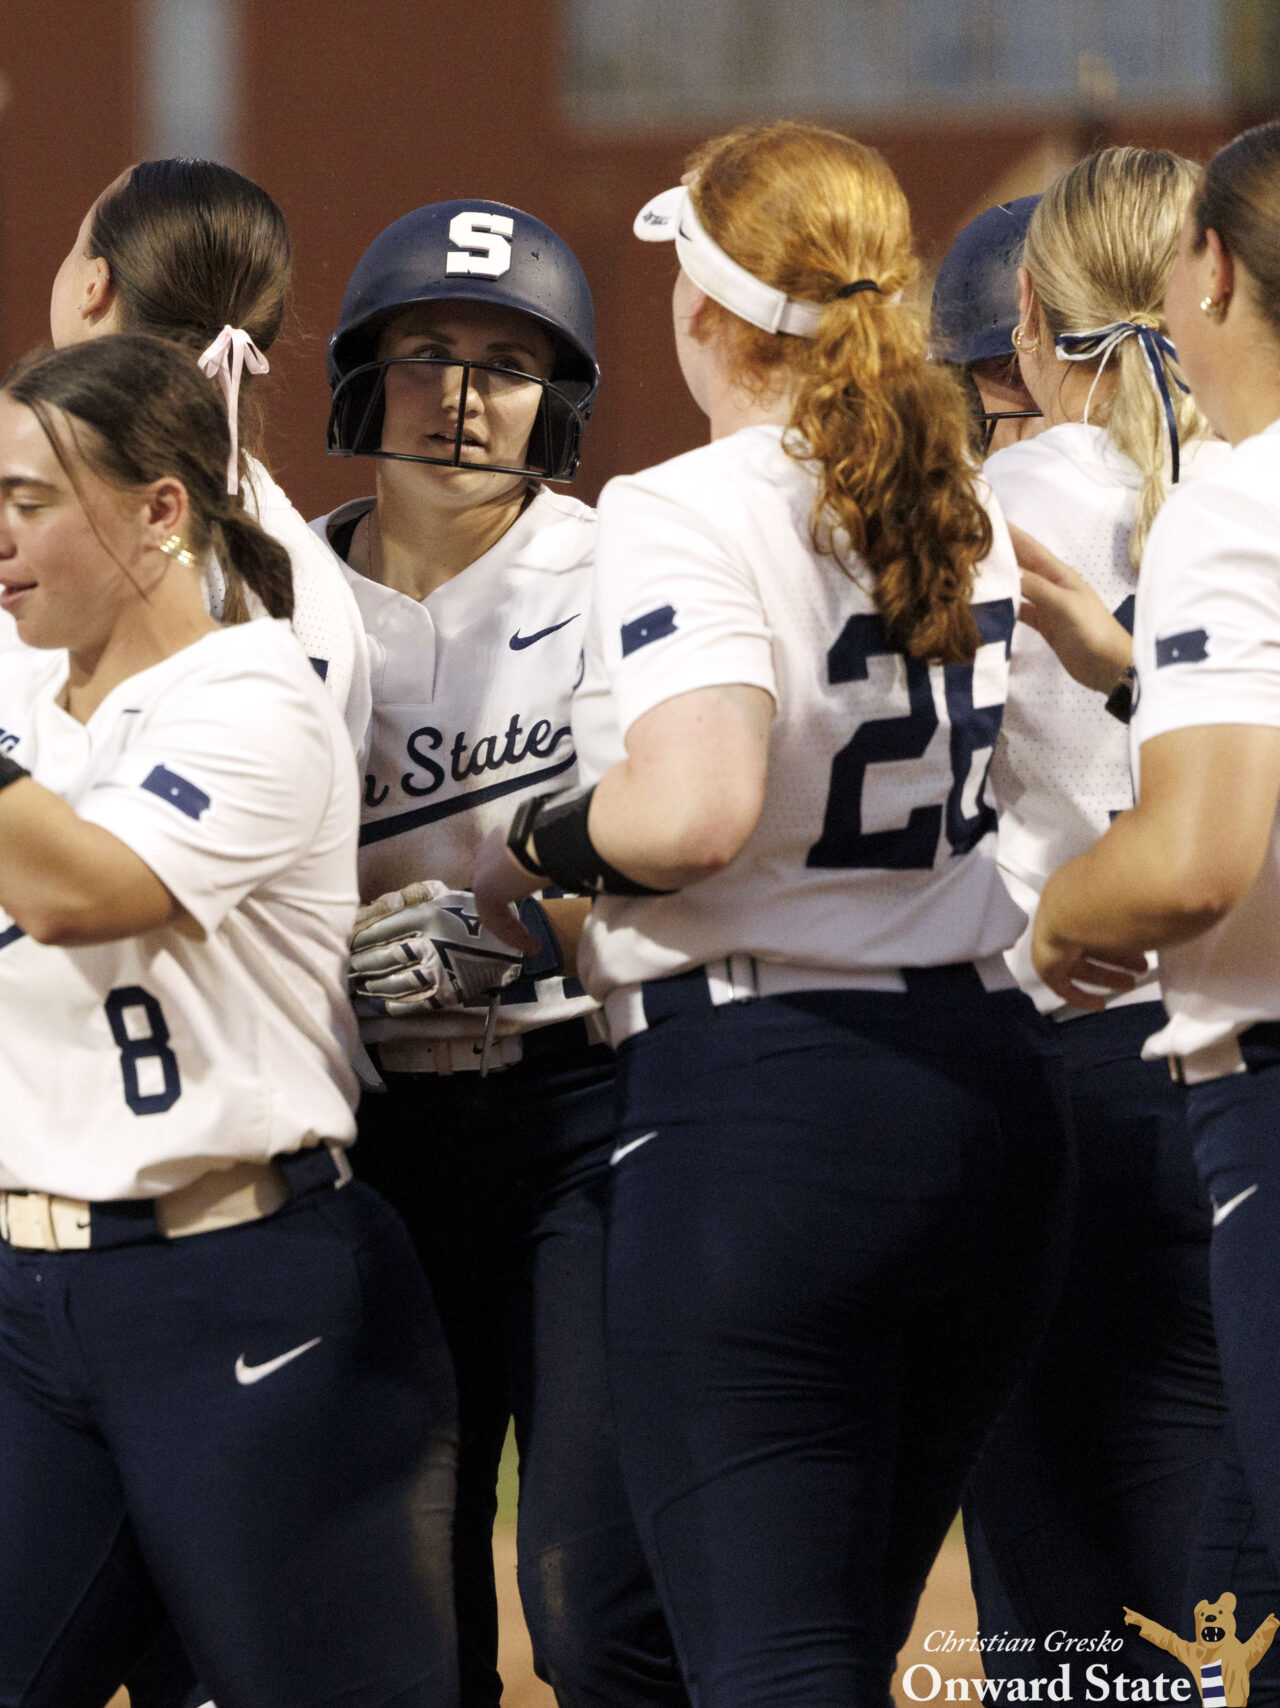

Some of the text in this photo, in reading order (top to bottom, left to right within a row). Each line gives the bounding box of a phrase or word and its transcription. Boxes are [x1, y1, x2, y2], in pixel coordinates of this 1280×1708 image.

[445, 211, 514, 279] S
[401, 713, 572, 796] State
[105, 985, 182, 1116] 8
